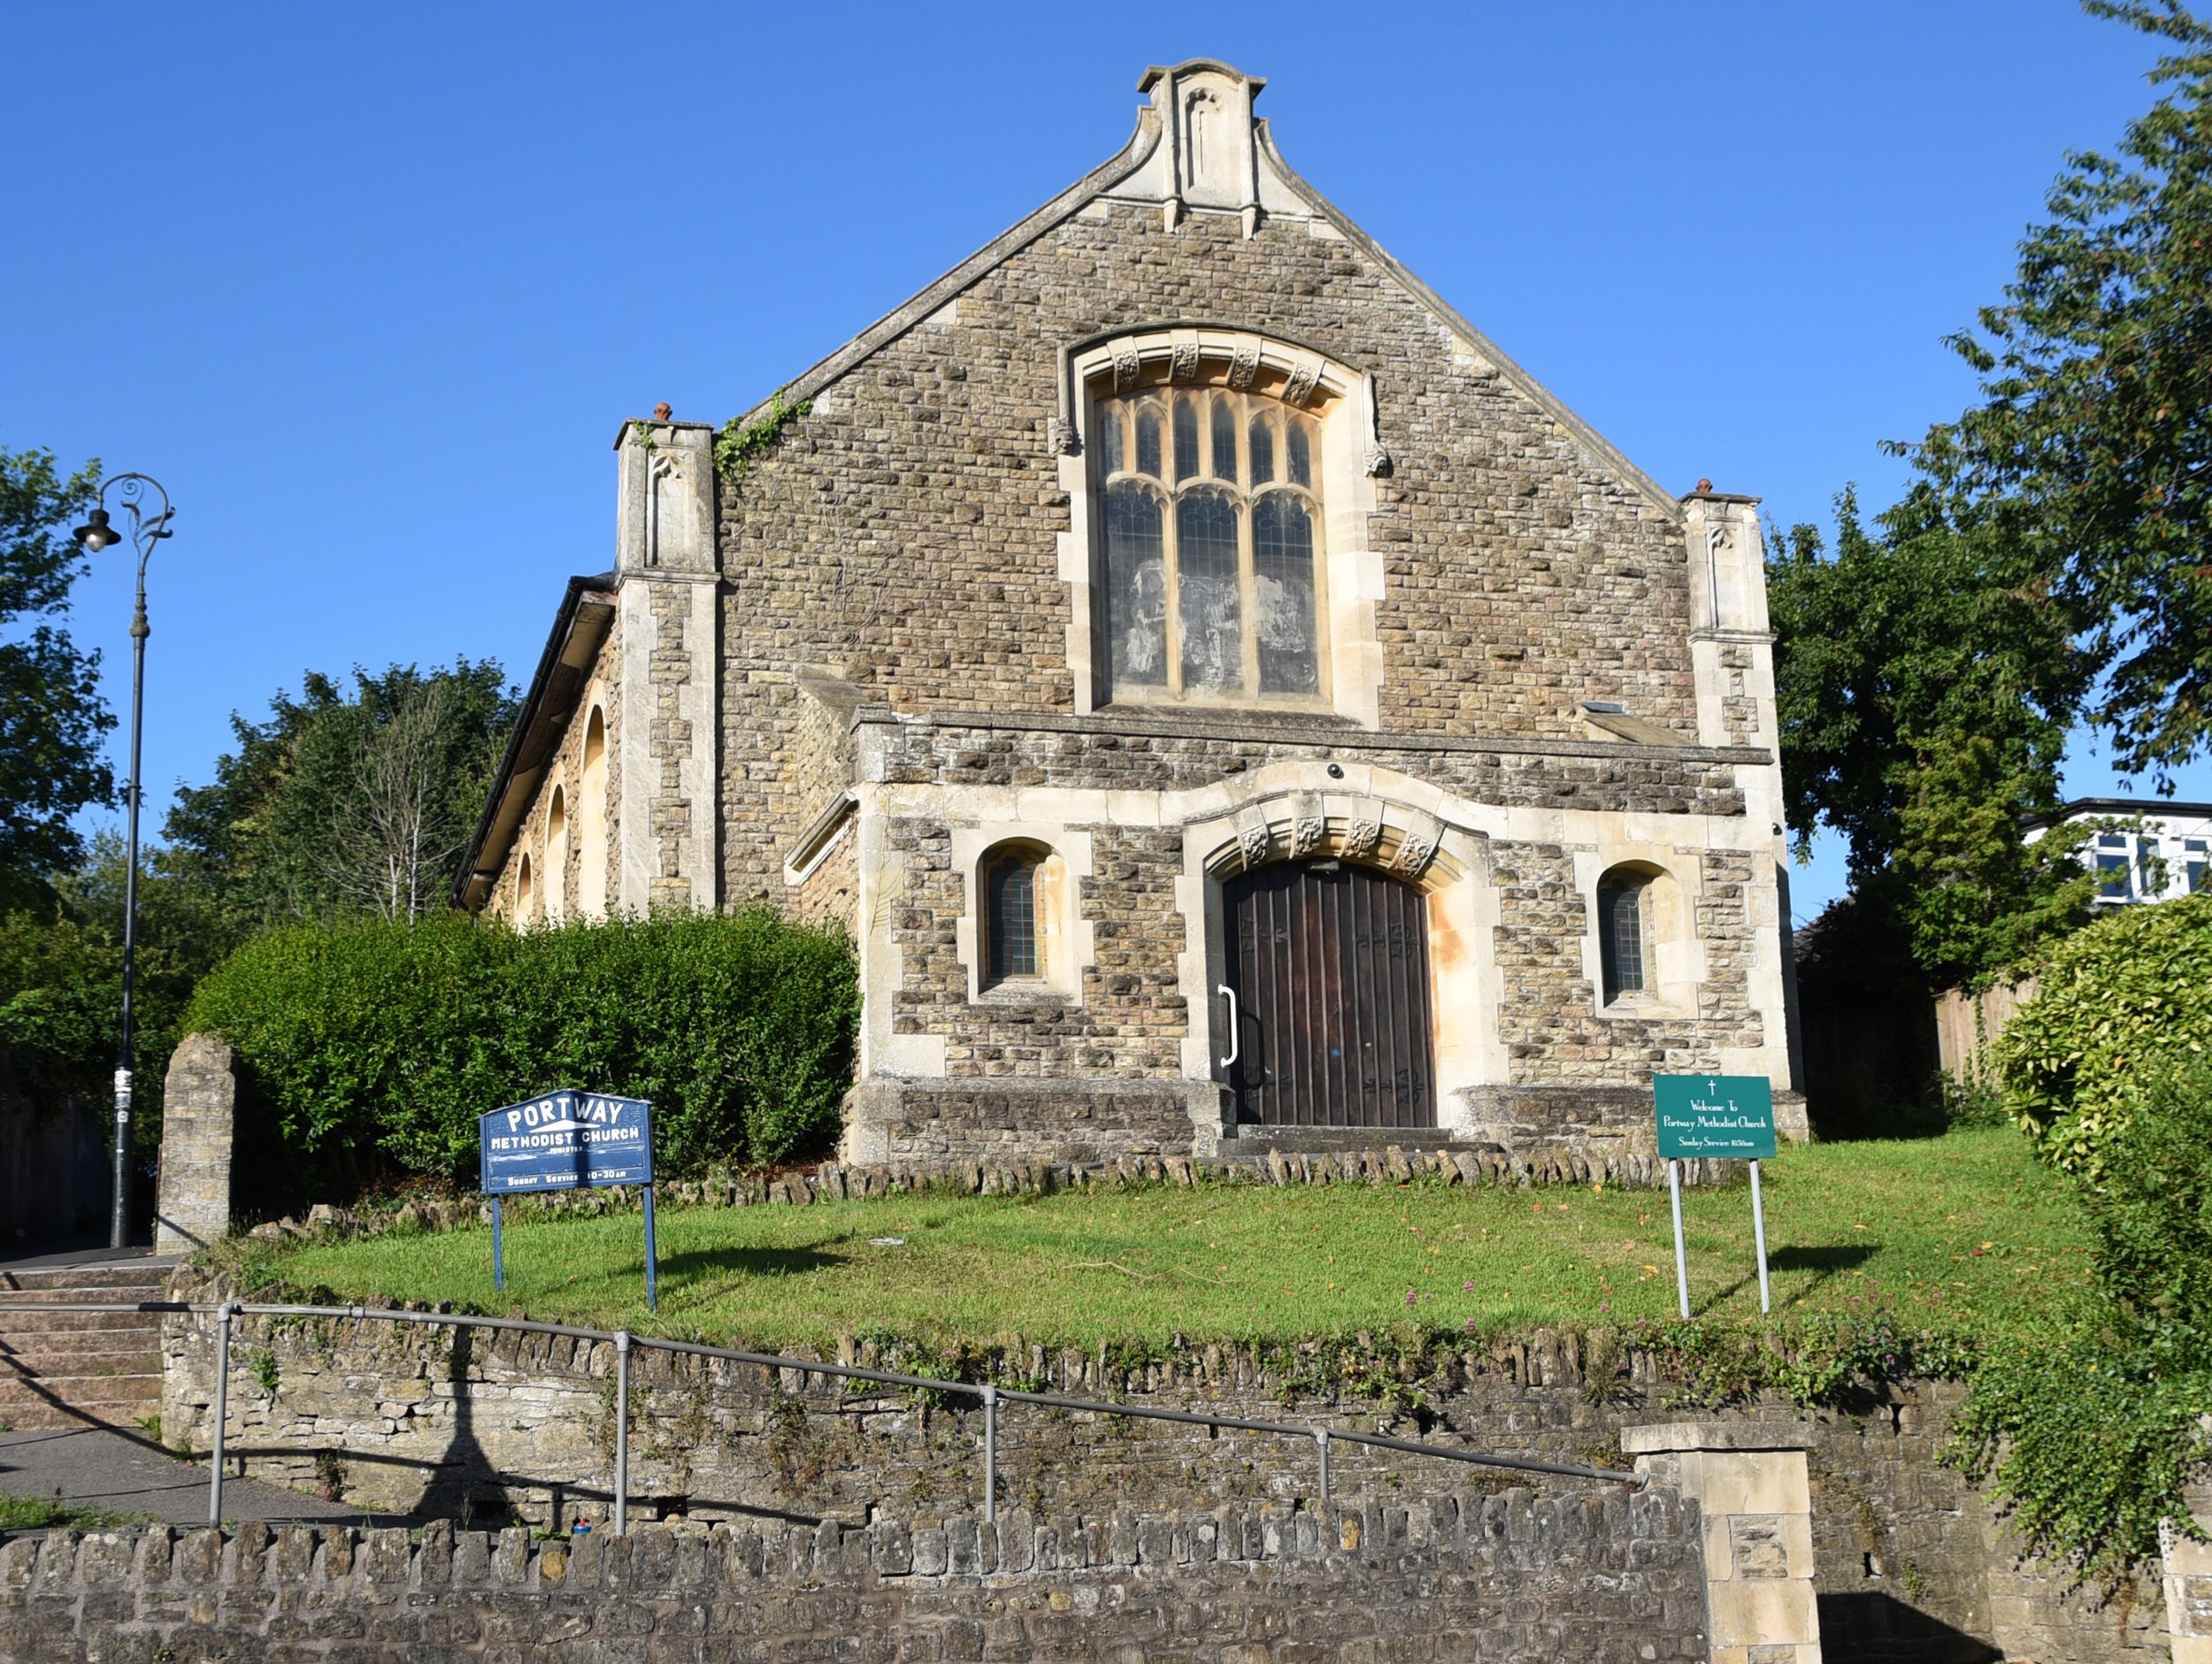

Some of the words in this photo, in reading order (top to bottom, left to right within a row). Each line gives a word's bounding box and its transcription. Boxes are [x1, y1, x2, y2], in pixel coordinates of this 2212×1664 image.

[1690, 1100, 1724, 1112] Welcome
[1727, 1100, 1738, 1112] To
[508, 1098, 623, 1132] PORTWAY
[1663, 1115, 1695, 1132] Portway
[1697, 1116, 1737, 1128] Methodist
[1738, 1116, 1766, 1128] Church
[491, 1132, 573, 1149] METHODIST
[581, 1127, 639, 1143] CHURCH
[1678, 1136, 1703, 1151] Sunday
[1703, 1136, 1729, 1146] Service
